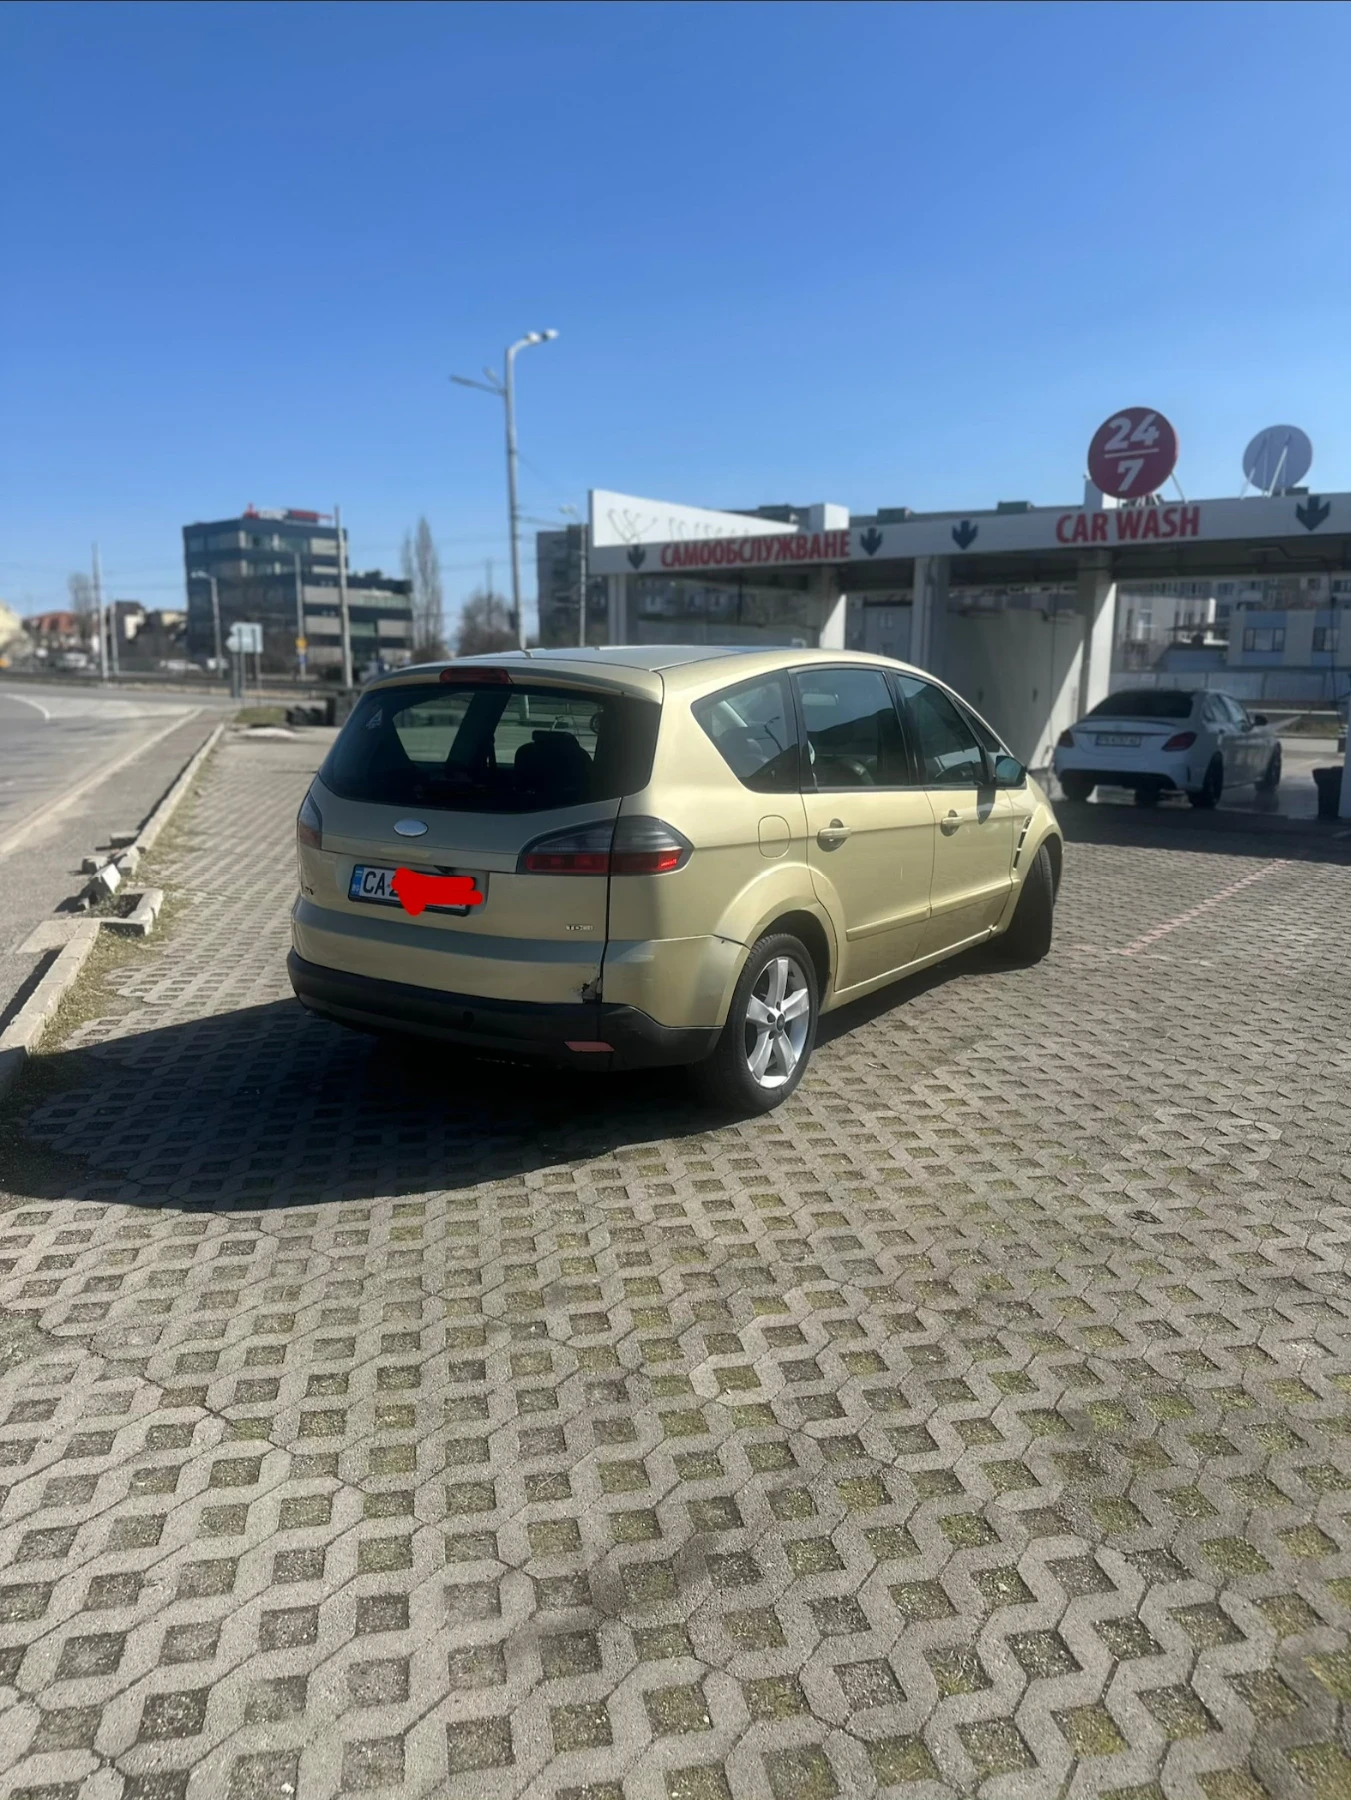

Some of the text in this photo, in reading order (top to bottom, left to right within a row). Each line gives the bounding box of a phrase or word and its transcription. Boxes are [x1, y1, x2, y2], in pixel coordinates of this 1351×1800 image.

[1104, 414, 1160, 450] 24
[1117, 458, 1145, 492] 7
[1056, 505, 1200, 544] CAR WASH
[660, 530, 851, 568] САМООБСЛУЖВАНЕ
